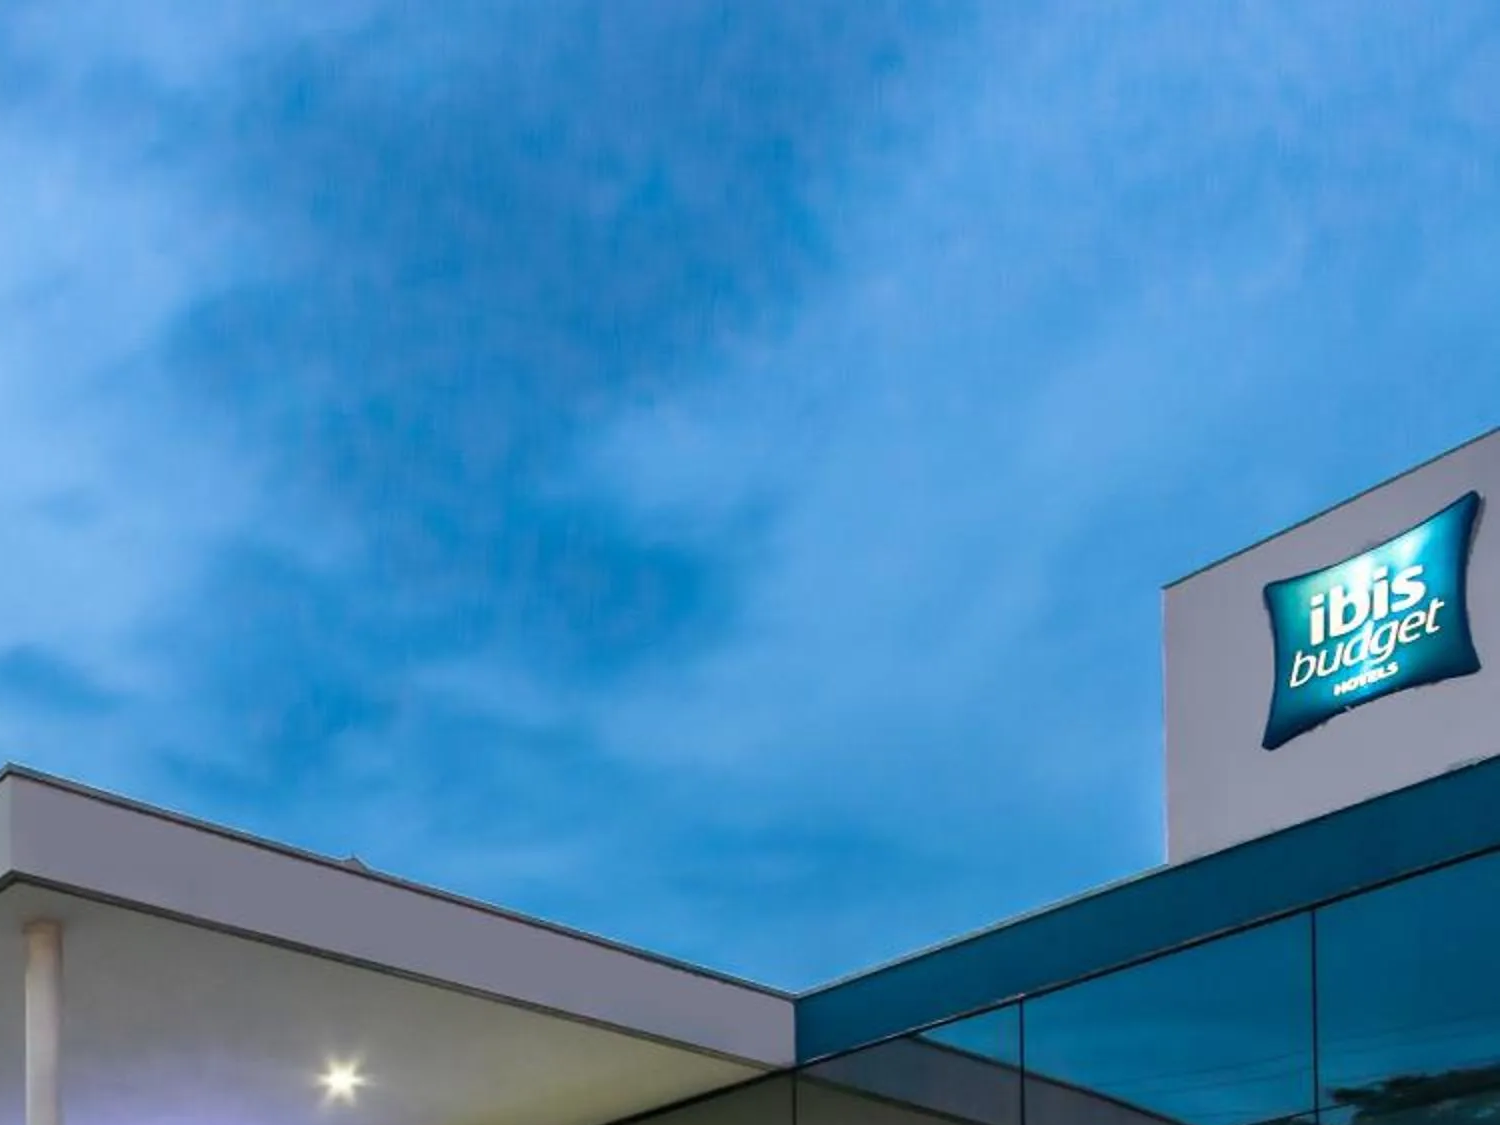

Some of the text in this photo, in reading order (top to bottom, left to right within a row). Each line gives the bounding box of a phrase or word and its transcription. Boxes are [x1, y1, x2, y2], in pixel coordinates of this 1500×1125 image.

[1289, 597, 1445, 689] budget
[1310, 565, 1427, 646] ibis
[1333, 661, 1399, 696] HOTELS
